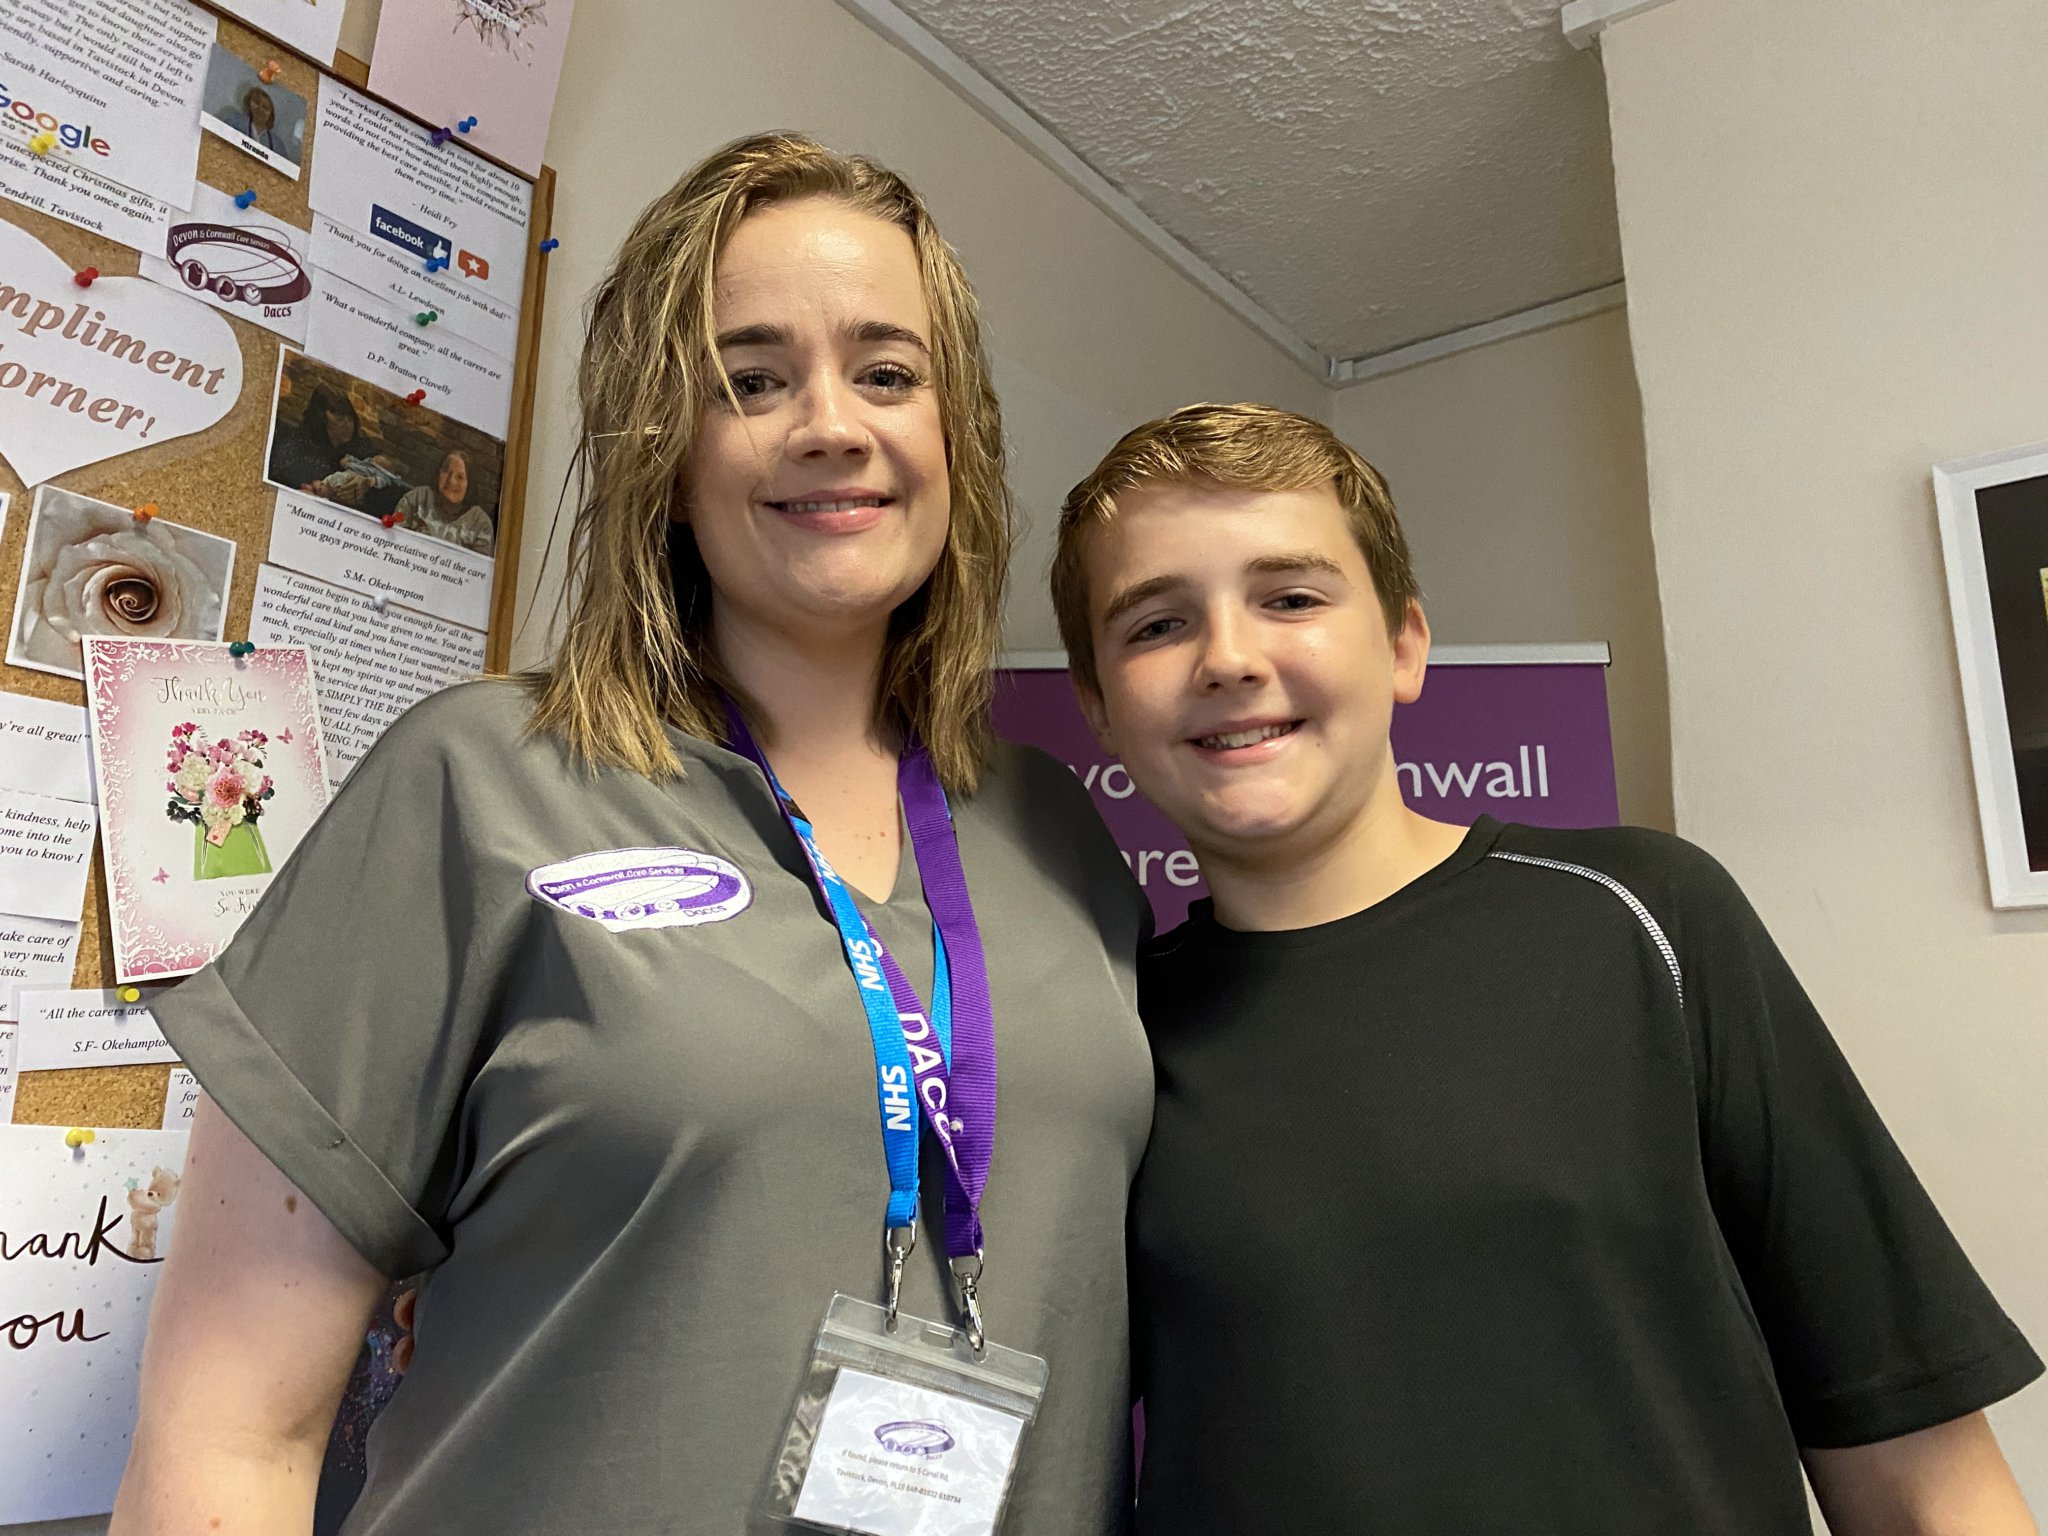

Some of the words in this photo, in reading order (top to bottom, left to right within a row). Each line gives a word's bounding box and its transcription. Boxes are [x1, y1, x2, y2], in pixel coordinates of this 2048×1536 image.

[5, 141, 71, 173] unexpected
[72, 168, 127, 198] Christmas
[128, 195, 155, 211] gifts,
[33, 165, 68, 187] Thank
[68, 183, 91, 197] you
[93, 193, 119, 208] once
[50, 202, 103, 231] Tavistock
[419, 204, 442, 220] Heidi
[443, 216, 458, 229] Fry
[173, 230, 198, 247] Devon
[206, 229, 236, 241] Cornwall
[375, 216, 424, 249] facebook
[354, 240, 372, 252] you
[371, 247, 386, 258] for
[386, 255, 410, 274] doing
[410, 269, 421, 278] an
[422, 275, 457, 296] excellent
[456, 292, 471, 302] job
[472, 299, 488, 311] with
[264, 306, 292, 318] Daccs
[408, 291, 445, 315] Lewdown
[357, 309, 399, 333] wonderful
[398, 329, 435, 351] company,
[437, 347, 449, 356] all
[449, 351, 462, 362] the
[463, 359, 487, 373] carers
[487, 370, 501, 380] are
[388, 360, 417, 381] Bratton
[418, 375, 452, 396] Clovelly
[298, 526, 318, 538] you
[318, 533, 341, 545] guys
[341, 541, 379, 559] provide.
[382, 551, 410, 568] Thank
[410, 563, 428, 574] you
[429, 569, 439, 578] so
[317, 517, 337, 528] and
[336, 521, 343, 531] I
[343, 526, 360, 536] are
[360, 532, 372, 541] so
[373, 536, 428, 560] appreciative
[429, 554, 441, 565] of
[439, 558, 452, 568] all
[452, 562, 466, 573] the
[467, 569, 486, 579] care
[368, 577, 424, 601] Okehampton
[263, 586, 311, 605] wonderful
[311, 601, 332, 612] care
[332, 605, 351, 618] that
[349, 613, 368, 623] you
[368, 616, 390, 630] have
[389, 625, 413, 637] given
[414, 631, 423, 640] to
[424, 635, 438, 645] me.
[441, 638, 457, 650] You
[457, 645, 472, 654] are
[472, 648, 484, 658] all
[292, 580, 324, 595] cannot
[325, 588, 349, 603] begin
[351, 598, 360, 607] to
[361, 599, 386, 616] thank
[384, 608, 404, 623] you
[403, 615, 433, 630] enough
[432, 623, 447, 633] for
[447, 628, 460, 637] all
[460, 631, 473, 642] the
[150, 676, 219, 706] Thank
[27, 726, 44, 737] all
[5, 809, 60, 828] kindness,
[64, 816, 91, 832] help
[27, 828, 50, 842] into
[53, 831, 72, 845] the
[26, 847, 39, 858] to
[41, 848, 74, 862] know
[76, 853, 84, 864] I
[648, 866, 685, 876] Services
[682, 905, 727, 918] Daccs
[0, 931, 24, 943] take
[27, 935, 54, 944] care
[57, 936, 71, 948] of
[3, 951, 30, 962] very
[32, 952, 65, 963] much
[848, 938, 884, 991] NHS
[67, 1007, 85, 1019] the
[89, 1008, 125, 1017] carers
[127, 1007, 147, 1016] are
[881, 1065, 911, 1132] NHS
[898, 1012, 959, 1170] DACC
[0, 1308, 110, 1350] ou
